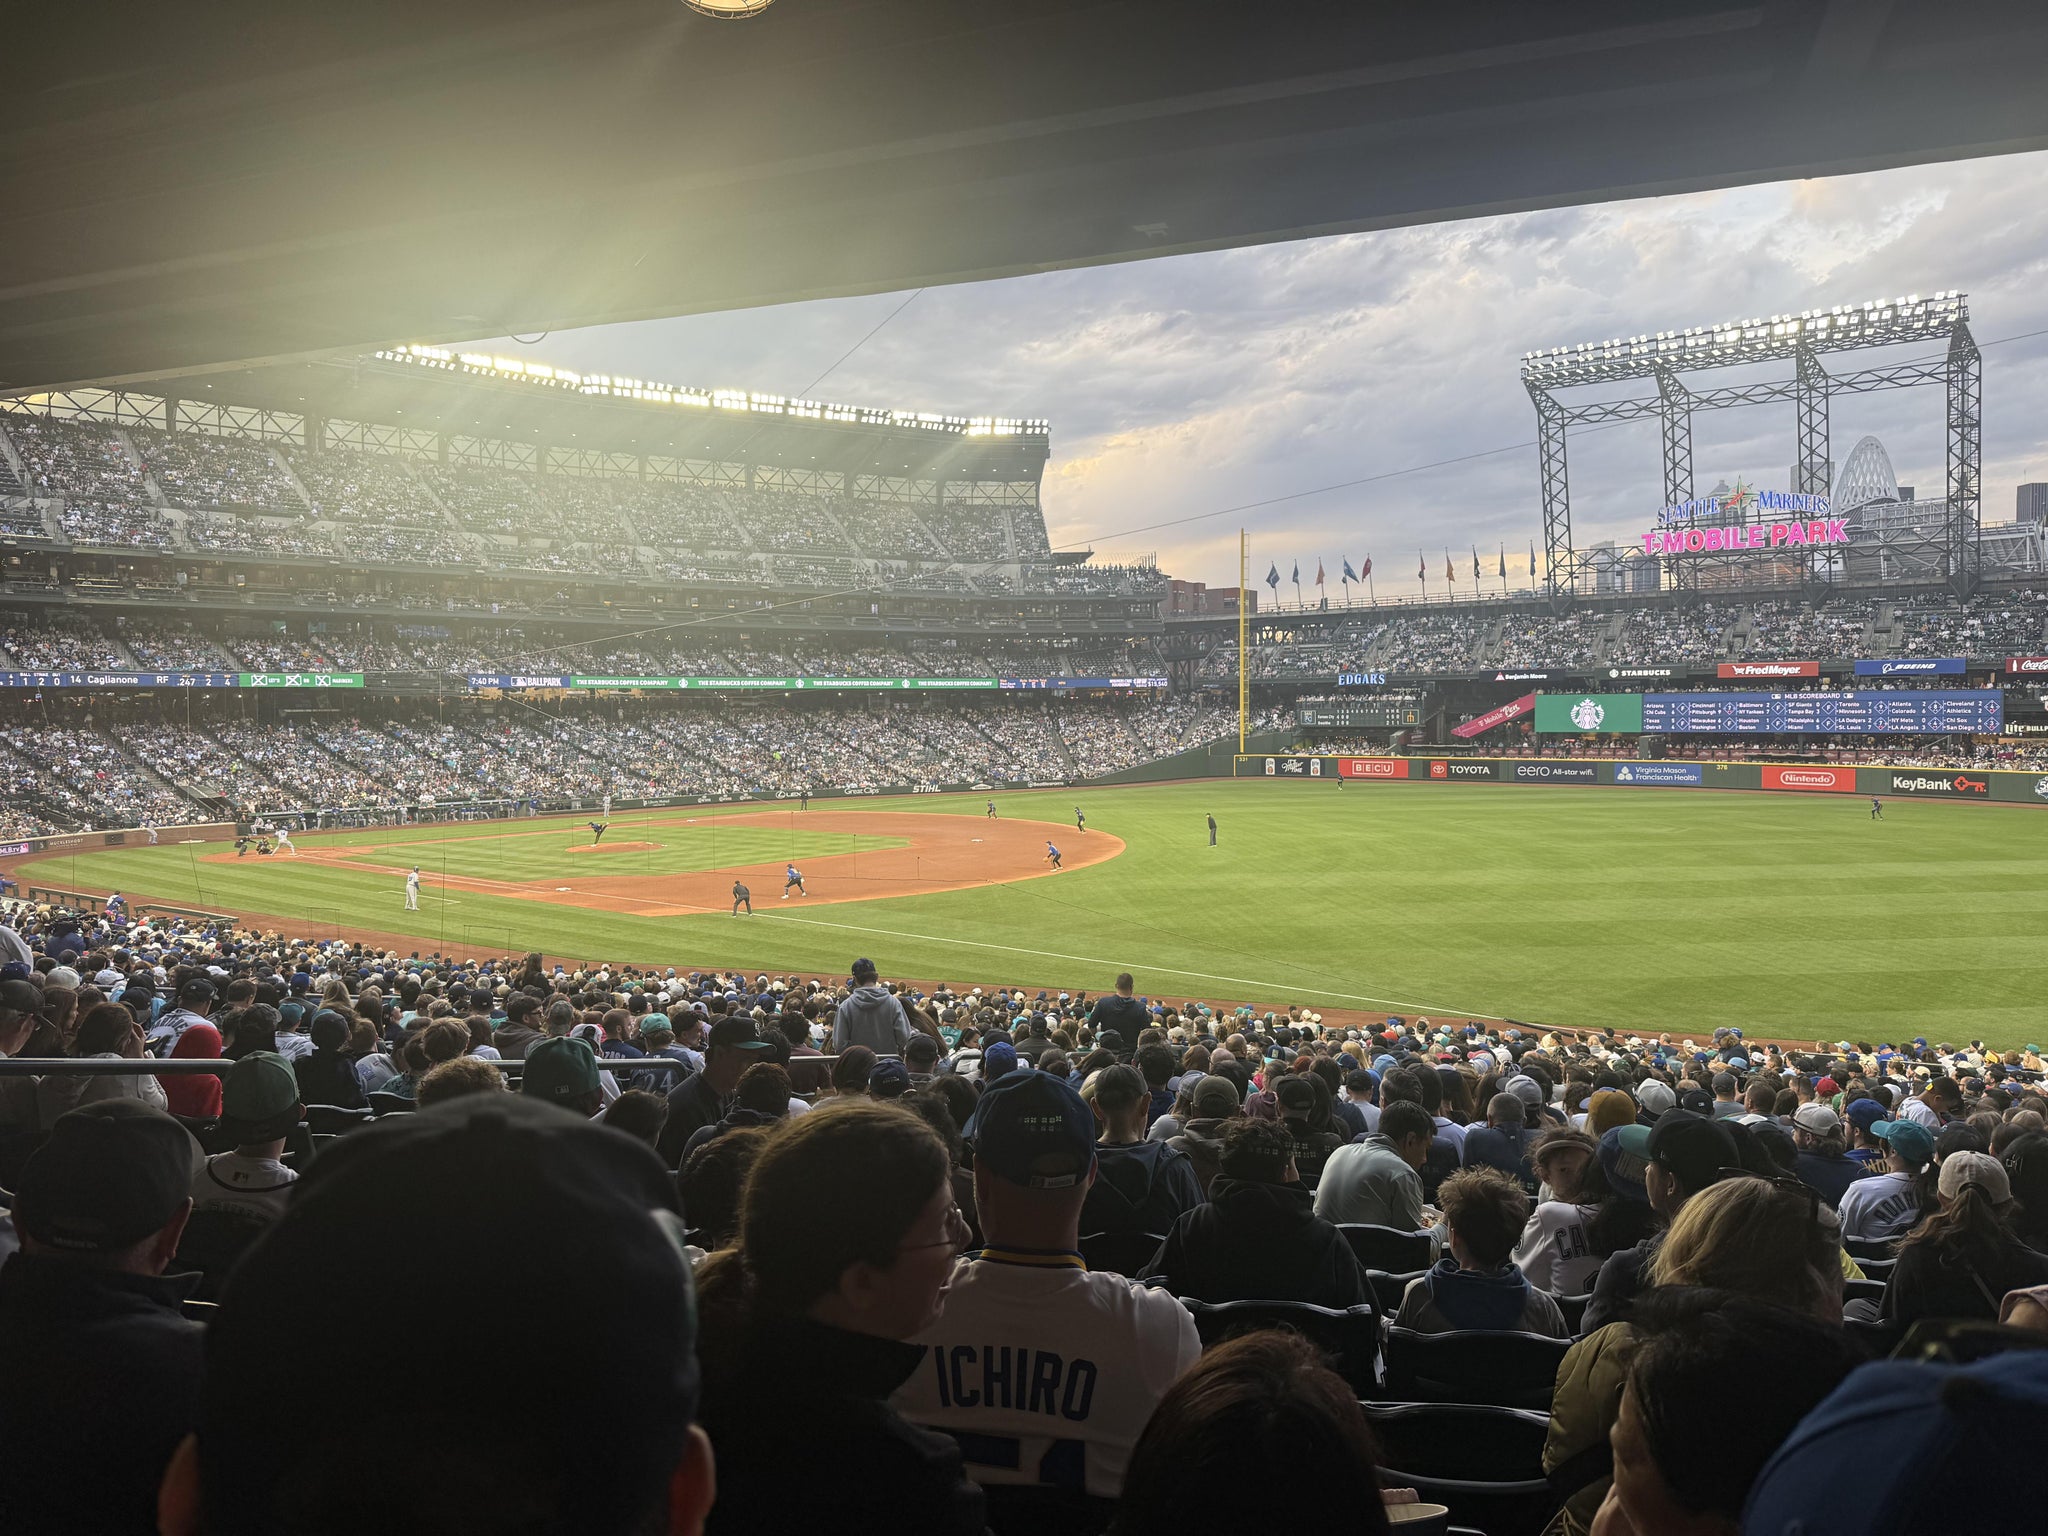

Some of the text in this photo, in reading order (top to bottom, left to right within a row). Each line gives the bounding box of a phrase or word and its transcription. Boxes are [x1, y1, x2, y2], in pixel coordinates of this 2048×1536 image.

[1657, 490, 1830, 526] SEATTLE MARINERS
[1640, 519, 1850, 555] T-MOBILE PARK
[23, 677, 28, 686] 1
[38, 677, 45, 686] 2
[54, 677, 60, 686] 0
[70, 675, 169, 686] 14 Caglianone RF
[176, 678, 196, 686] .247
[205, 678, 212, 686] 2
[224, 678, 231, 686] 4
[527, 678, 561, 686] BALLPARK
[1501, 704, 1520, 718] Pen
[1355, 764, 1391, 773] BECU
[1450, 765, 1490, 775] TOYOTA
[1517, 765, 1550, 777] eero
[1635, 766, 1661, 776] Virginia
[1674, 774, 1697, 782] Health
[1785, 774, 1832, 783] Nintendo
[1893, 776, 1951, 791] KeyBank
[844, 787, 880, 795] Great Clips
[912, 785, 941, 793] STIHL
[935, 1345, 1097, 1422] ICHIRO
